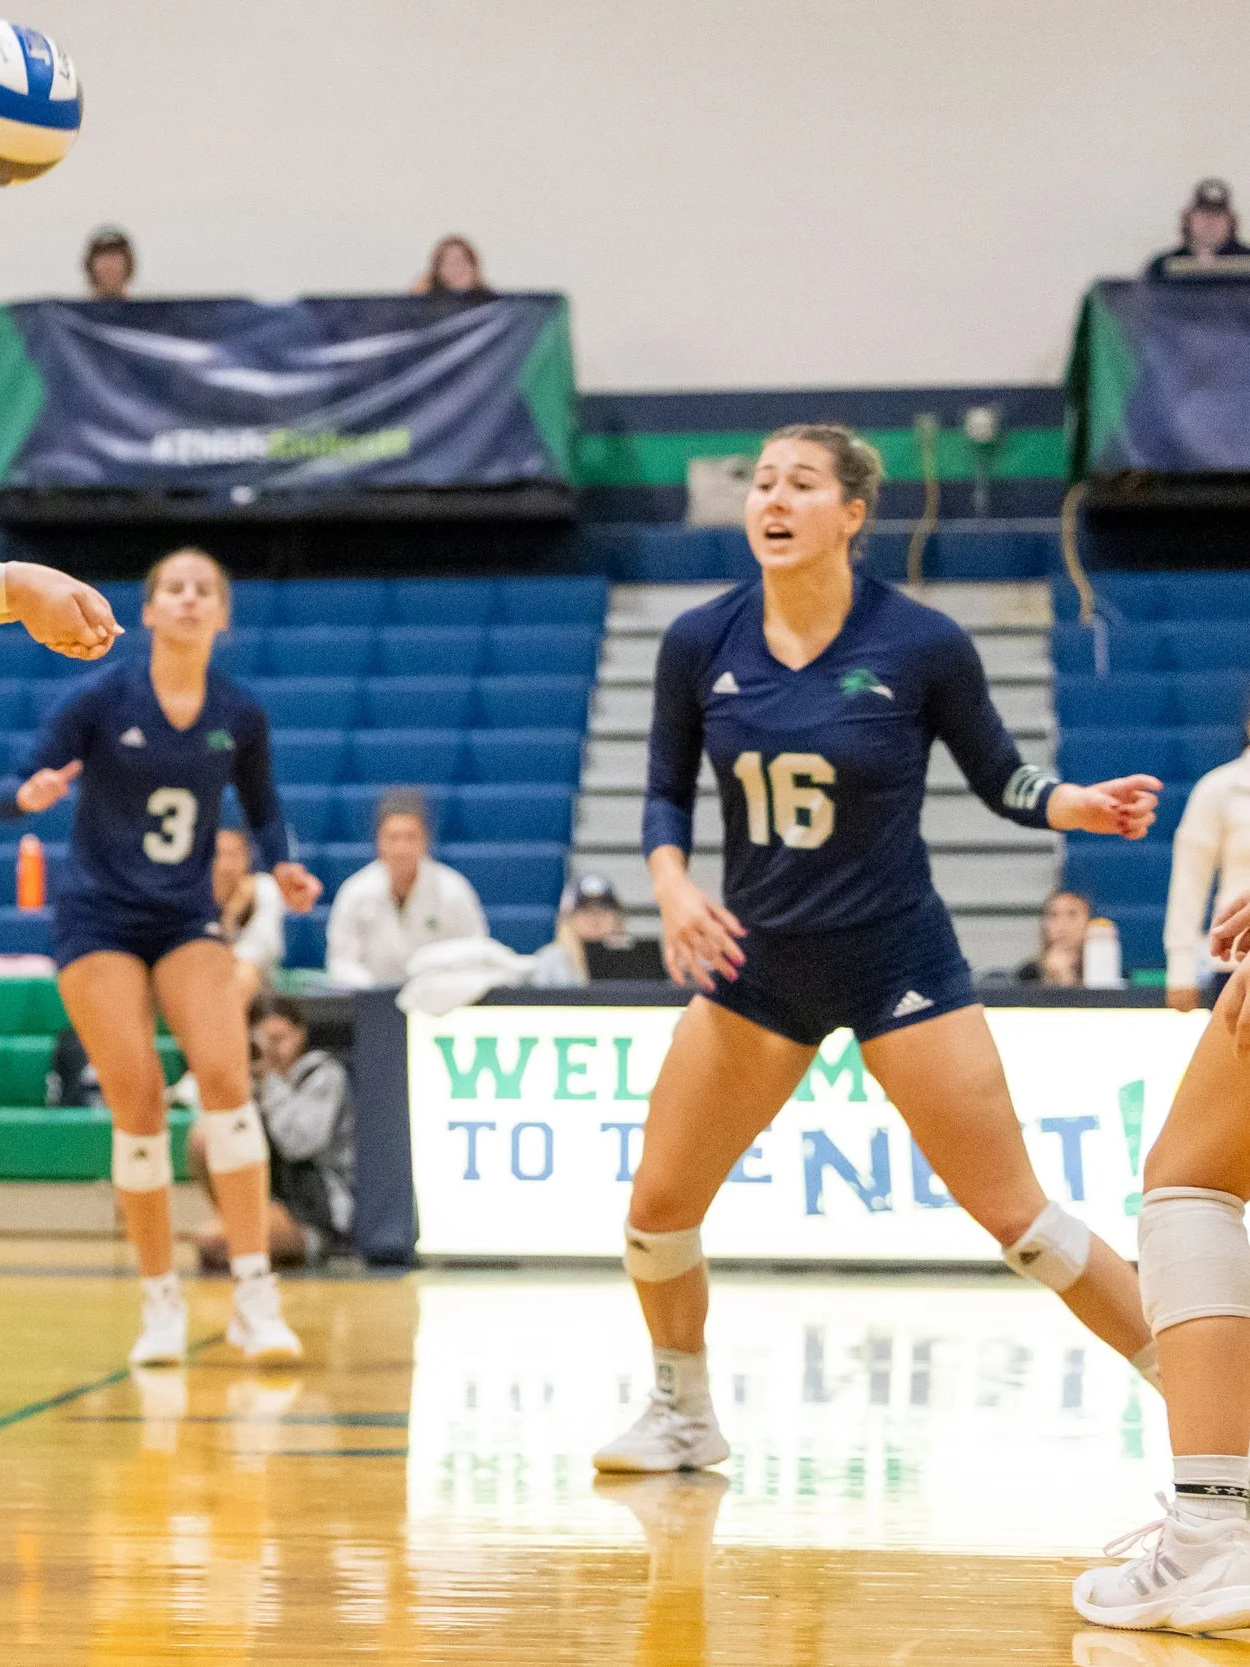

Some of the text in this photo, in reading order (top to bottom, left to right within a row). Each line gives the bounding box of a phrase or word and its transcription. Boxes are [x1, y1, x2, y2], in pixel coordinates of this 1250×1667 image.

[143, 786, 198, 865] 3
[734, 751, 836, 849] 16
[434, 1036, 888, 1101] WELM
[448, 1121, 553, 1181] TO
[600, 1122, 772, 1183] TE
